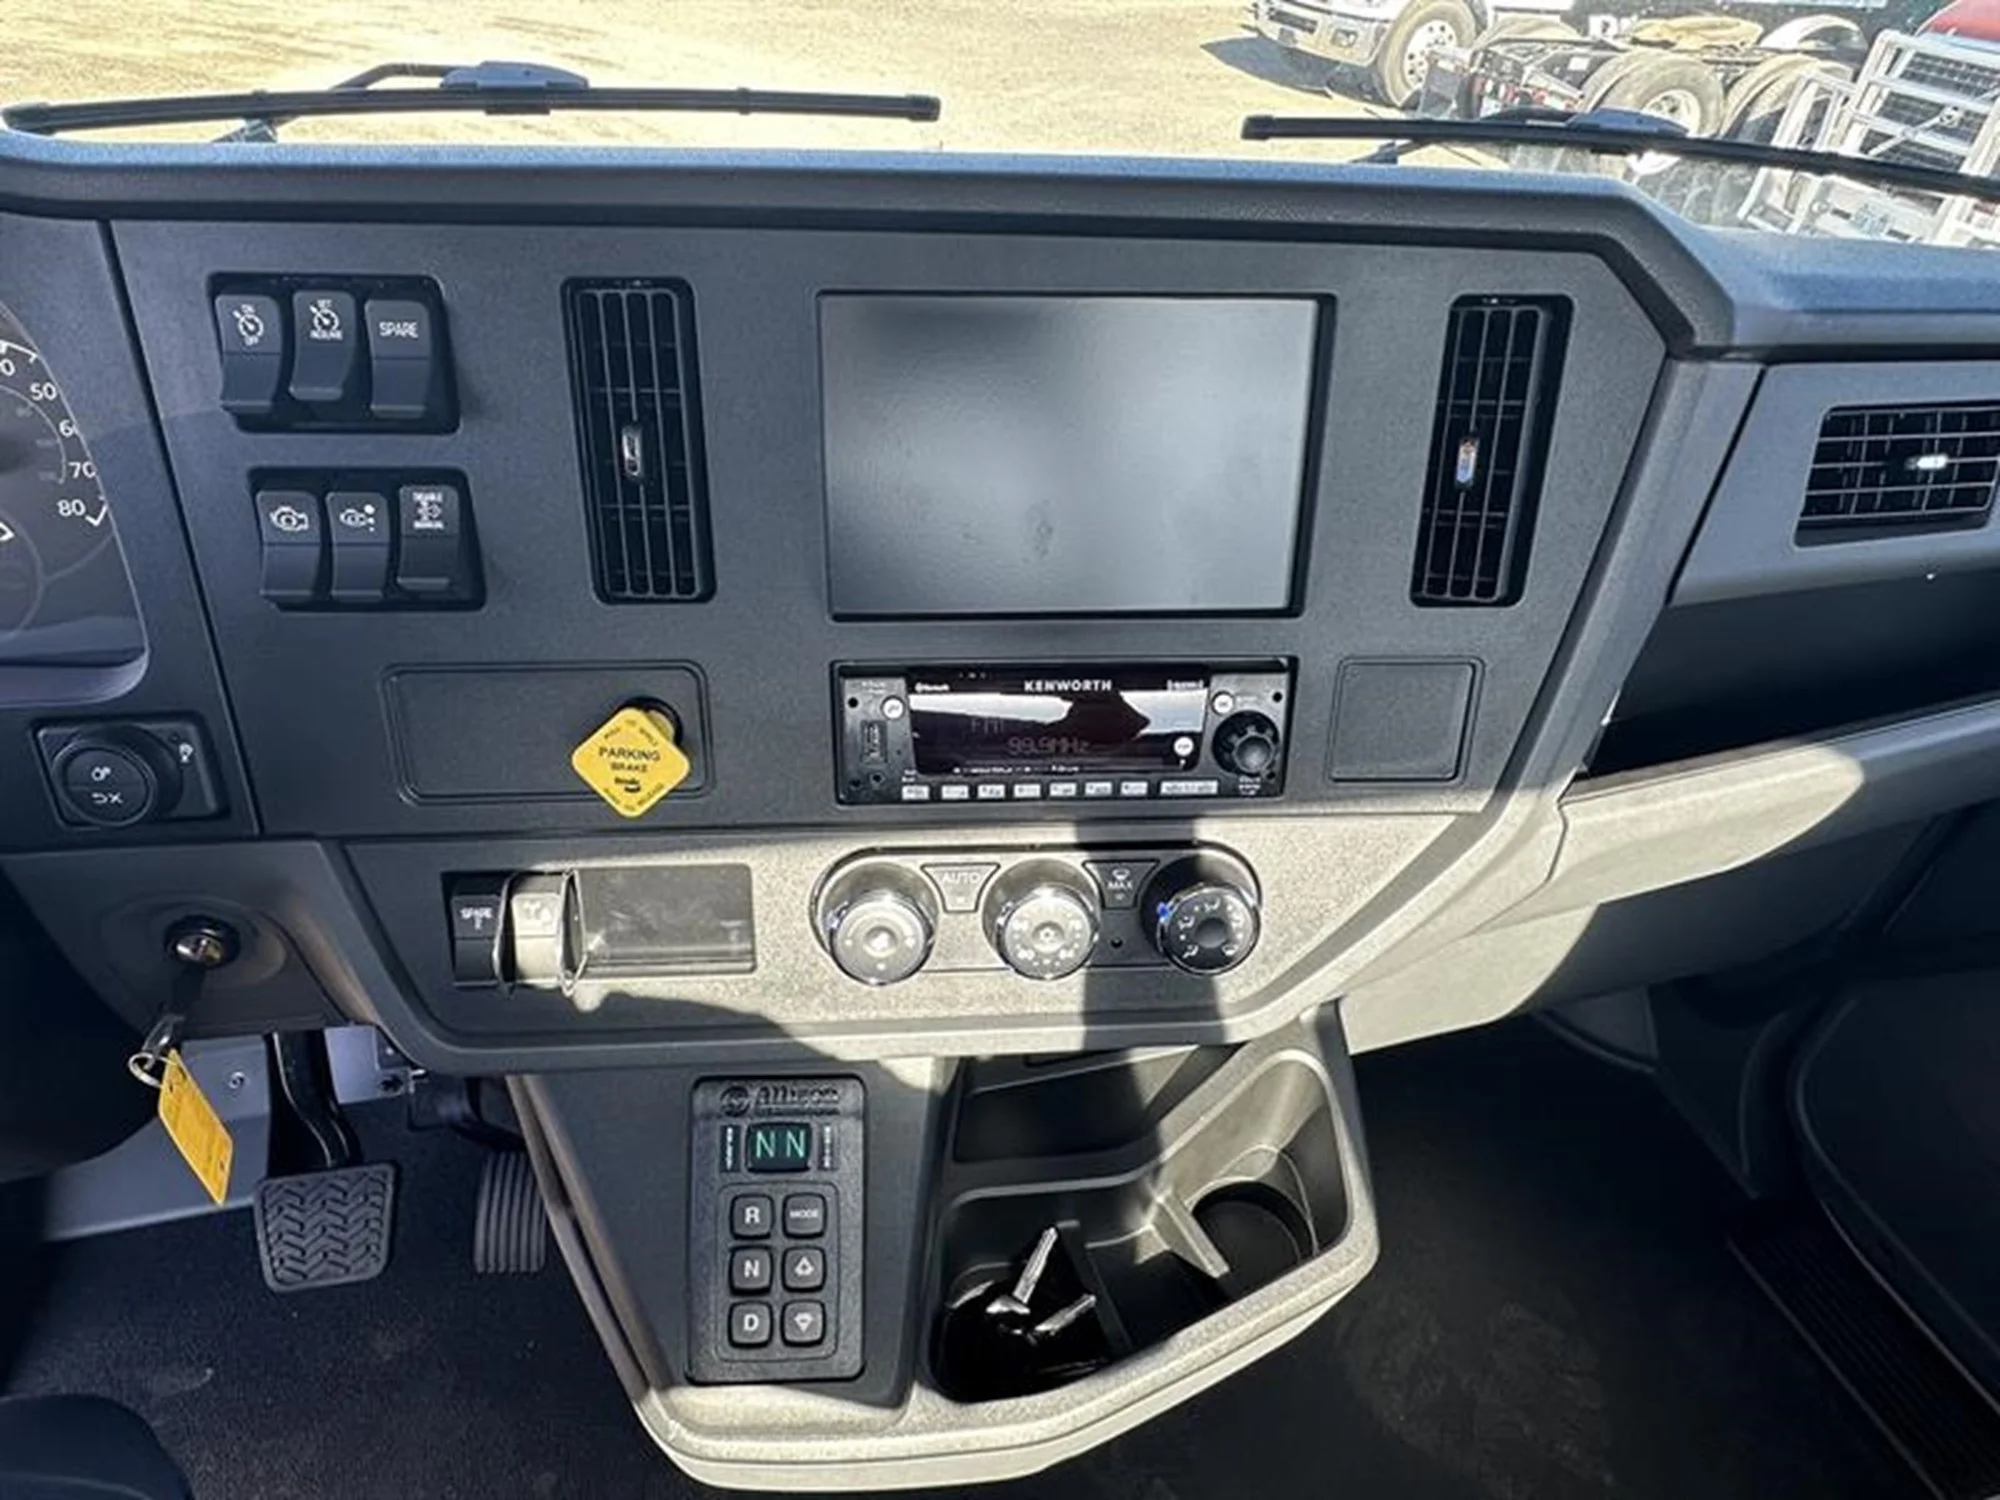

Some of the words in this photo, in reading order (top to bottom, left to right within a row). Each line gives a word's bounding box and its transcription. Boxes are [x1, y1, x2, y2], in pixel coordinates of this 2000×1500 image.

[379, 321, 418, 338] SPARE
[30, 382, 57, 401] 50
[57, 499, 86, 516] 80
[1024, 679, 1112, 692] KENWORTH
[598, 746, 661, 763] PARKING
[610, 762, 648, 774] BRAKE
[942, 871, 981, 885] AUTO
[744, 1206, 760, 1225] R
[789, 1208, 820, 1219] MODE
[743, 1260, 760, 1278] N
[743, 1314, 760, 1332] D
